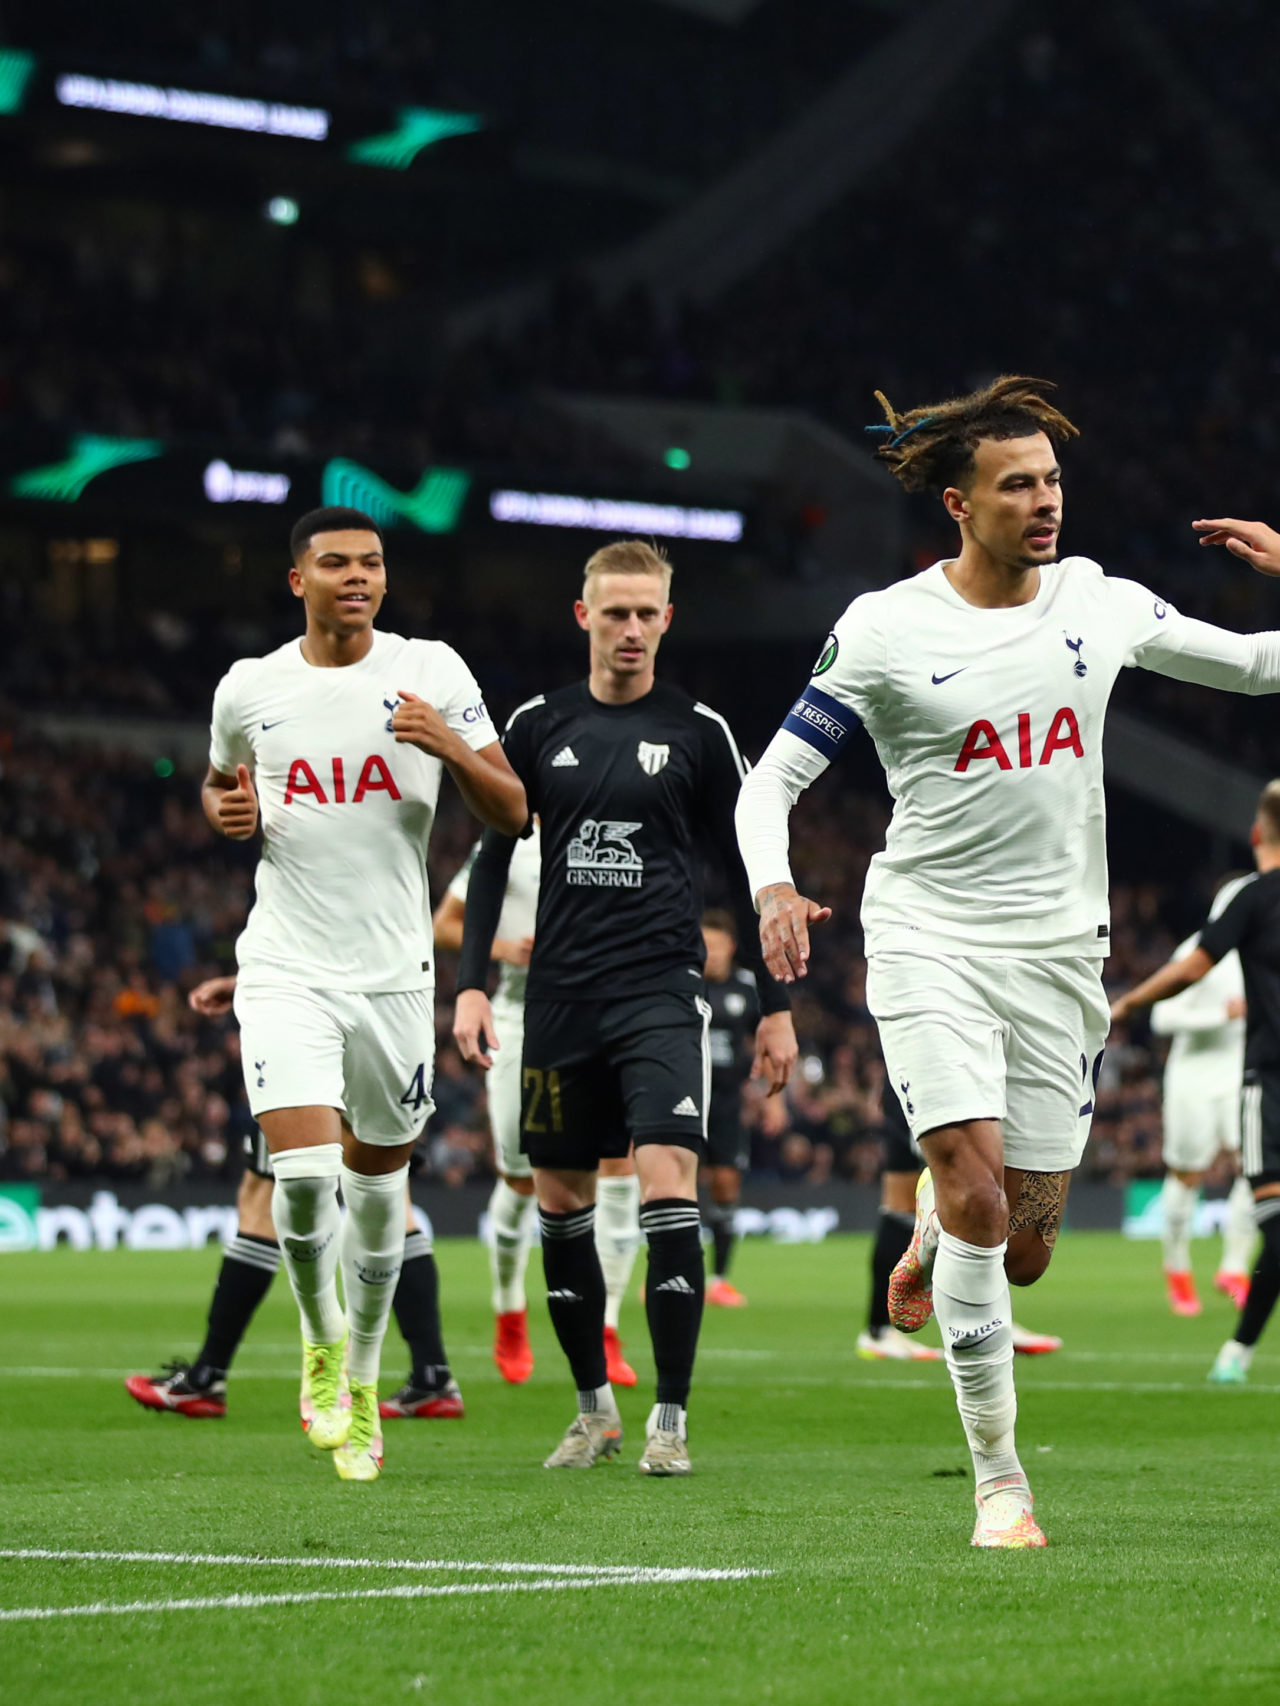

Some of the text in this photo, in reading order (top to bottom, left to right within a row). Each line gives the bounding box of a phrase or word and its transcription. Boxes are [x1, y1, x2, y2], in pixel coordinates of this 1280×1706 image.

[803, 707, 845, 739] RESPECT
[953, 706, 1084, 772] AIA
[284, 754, 402, 804] AIA
[566, 869, 643, 888] GENERALI
[400, 1063, 427, 1111] 4
[523, 1067, 563, 1132] 21
[948, 1318, 1003, 1339] SPURS
